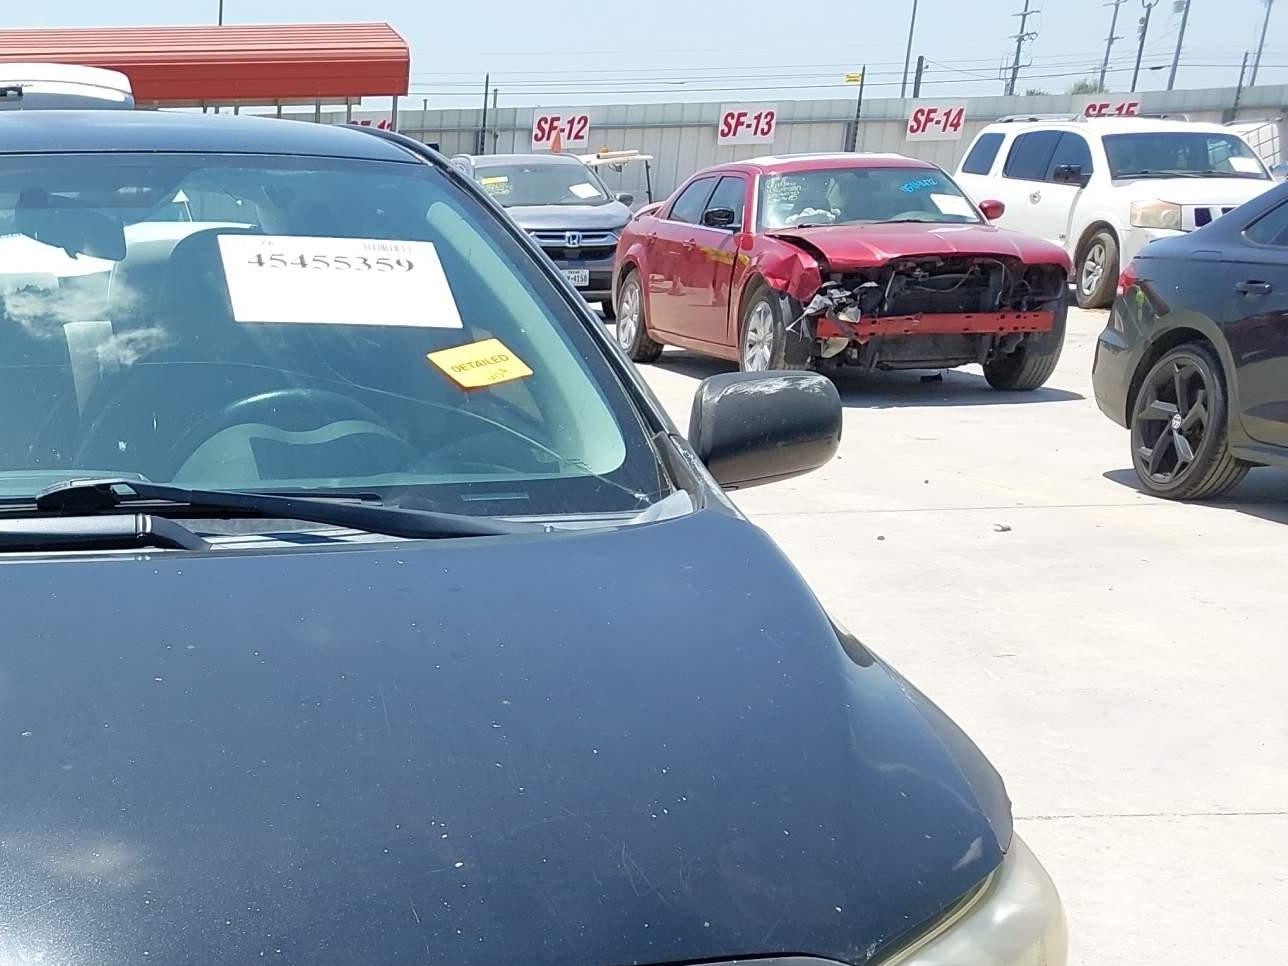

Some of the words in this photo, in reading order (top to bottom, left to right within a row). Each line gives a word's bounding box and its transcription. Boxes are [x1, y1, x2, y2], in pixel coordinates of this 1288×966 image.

[534, 115, 589, 142] SF-12
[720, 111, 775, 138] SF-13
[909, 107, 965, 134] SF-14
[247, 253, 414, 272] 45455359
[451, 354, 510, 373] DETAILED
